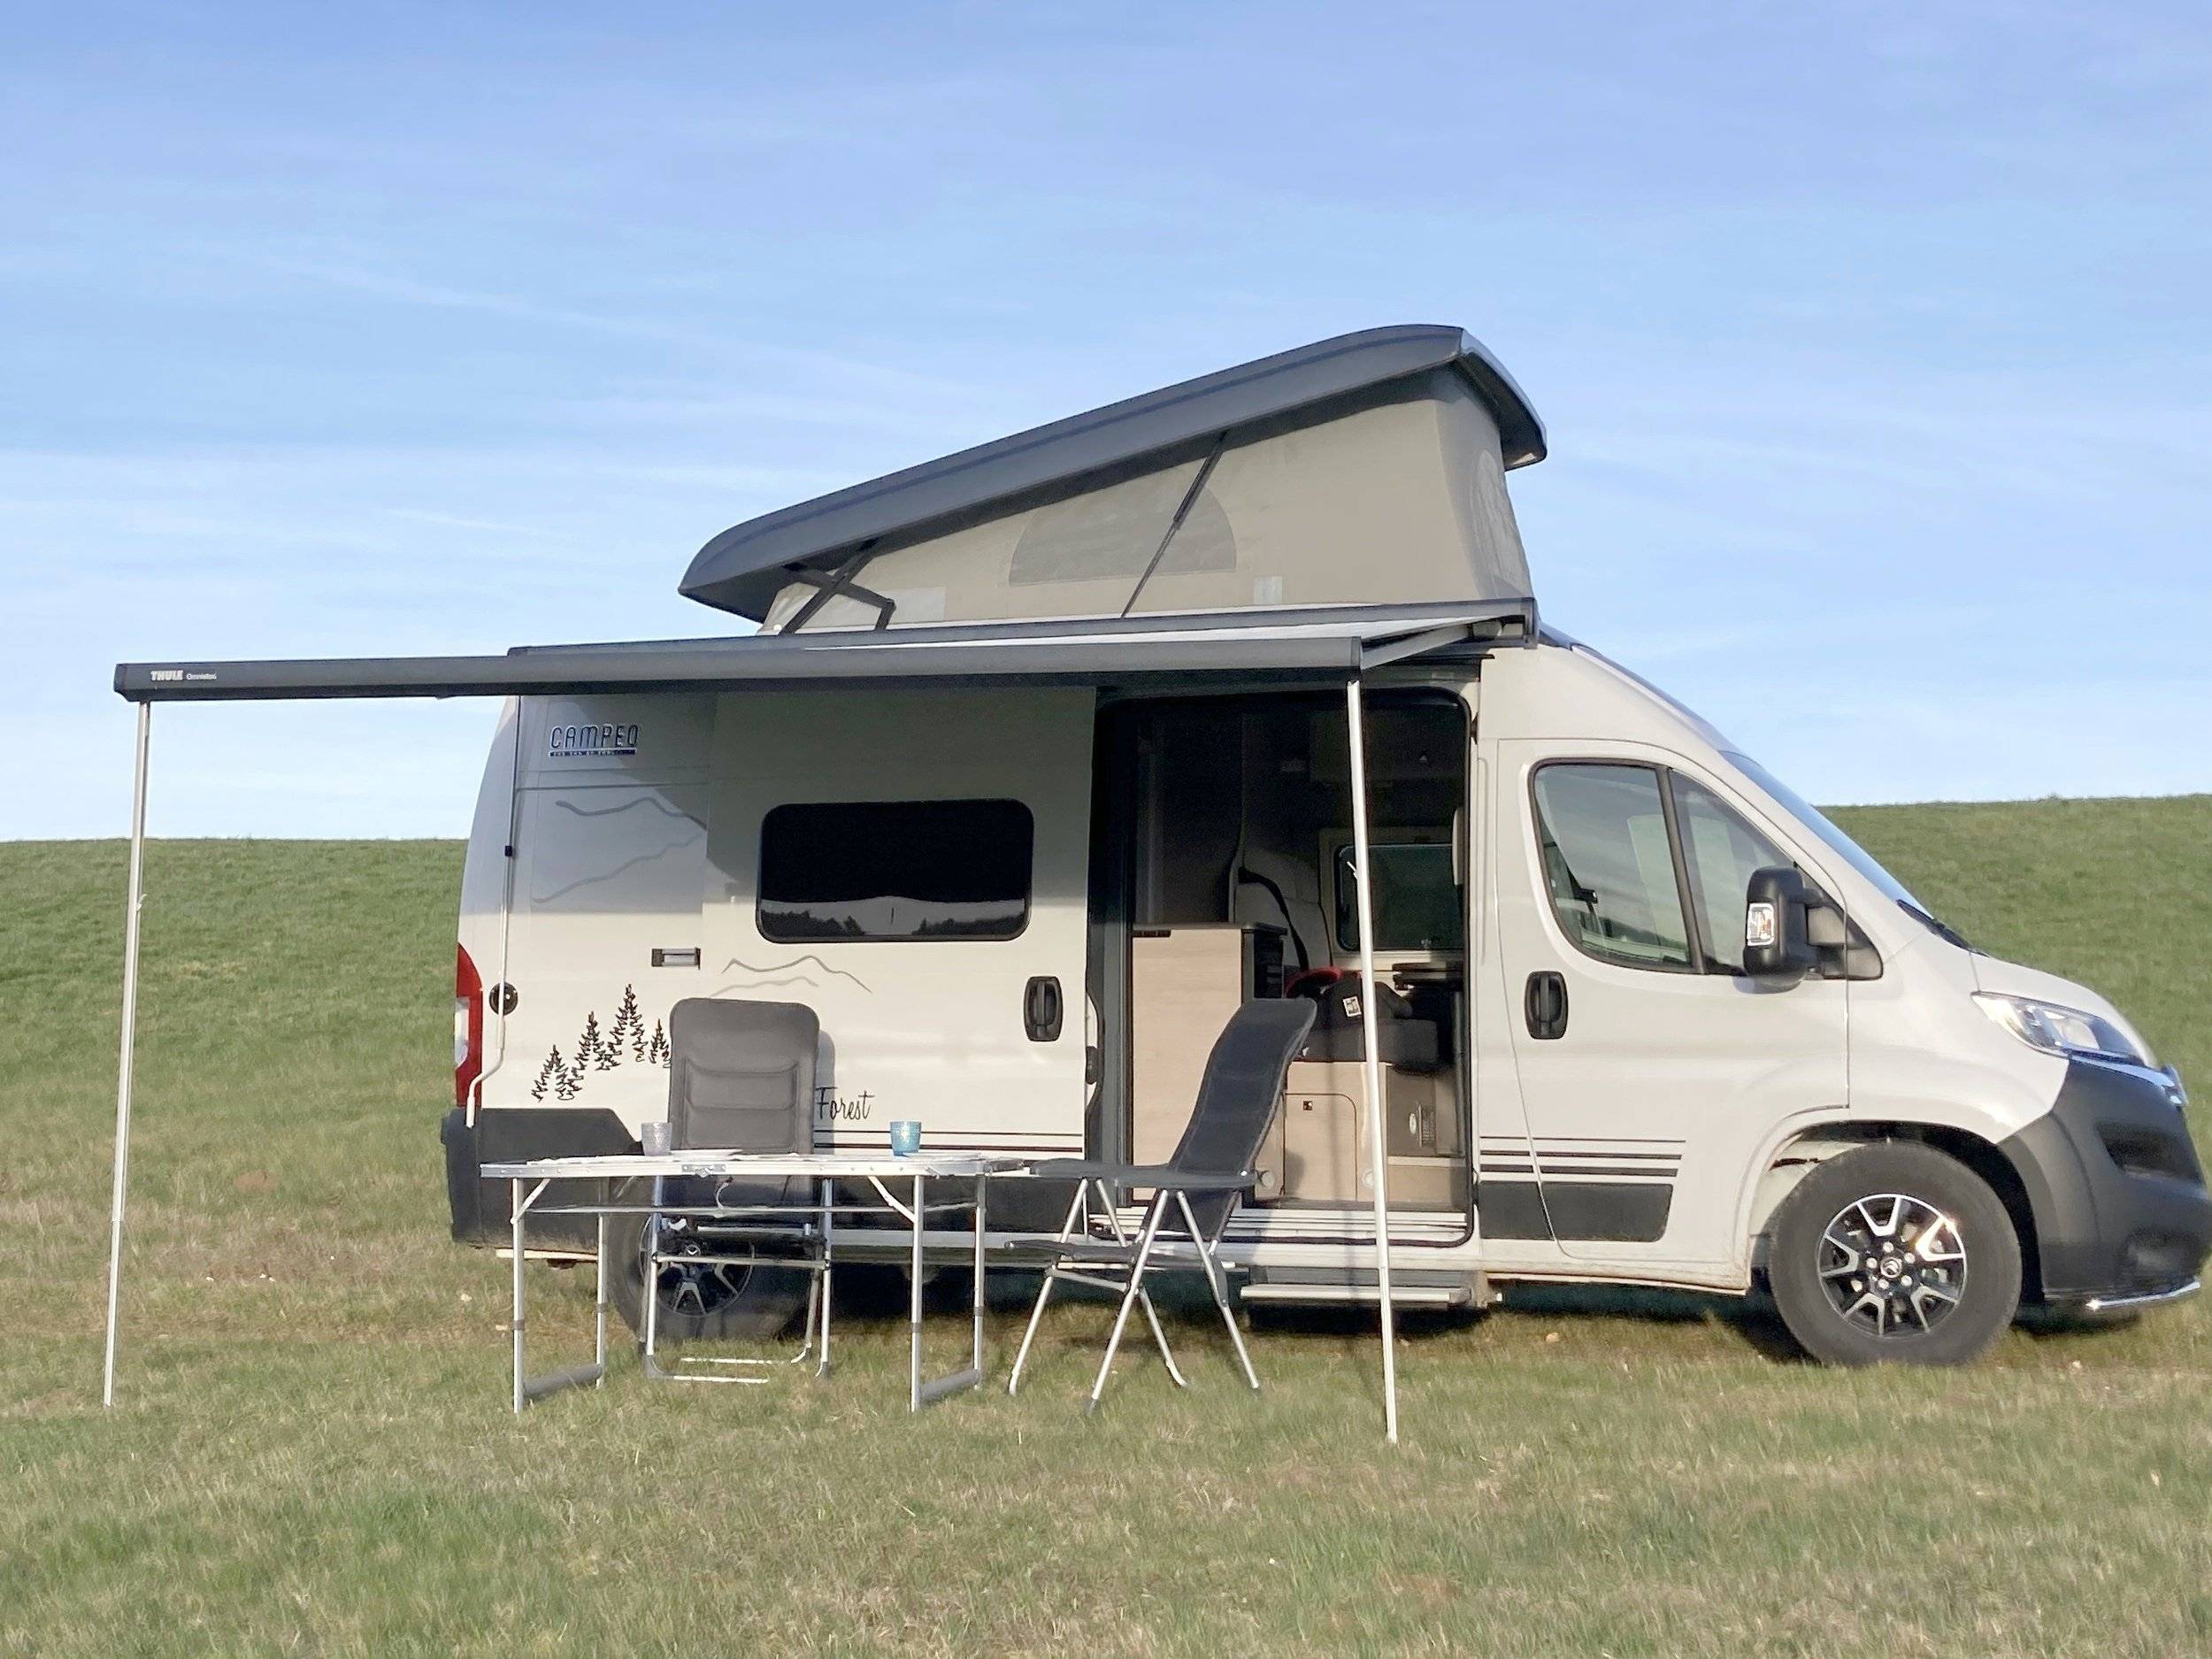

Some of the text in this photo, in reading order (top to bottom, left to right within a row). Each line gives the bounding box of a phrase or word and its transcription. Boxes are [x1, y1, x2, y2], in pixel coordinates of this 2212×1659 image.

[150, 670, 184, 681] THULE
[550, 725, 638, 749] CAMPEO
[814, 1086, 875, 1120] Forest
